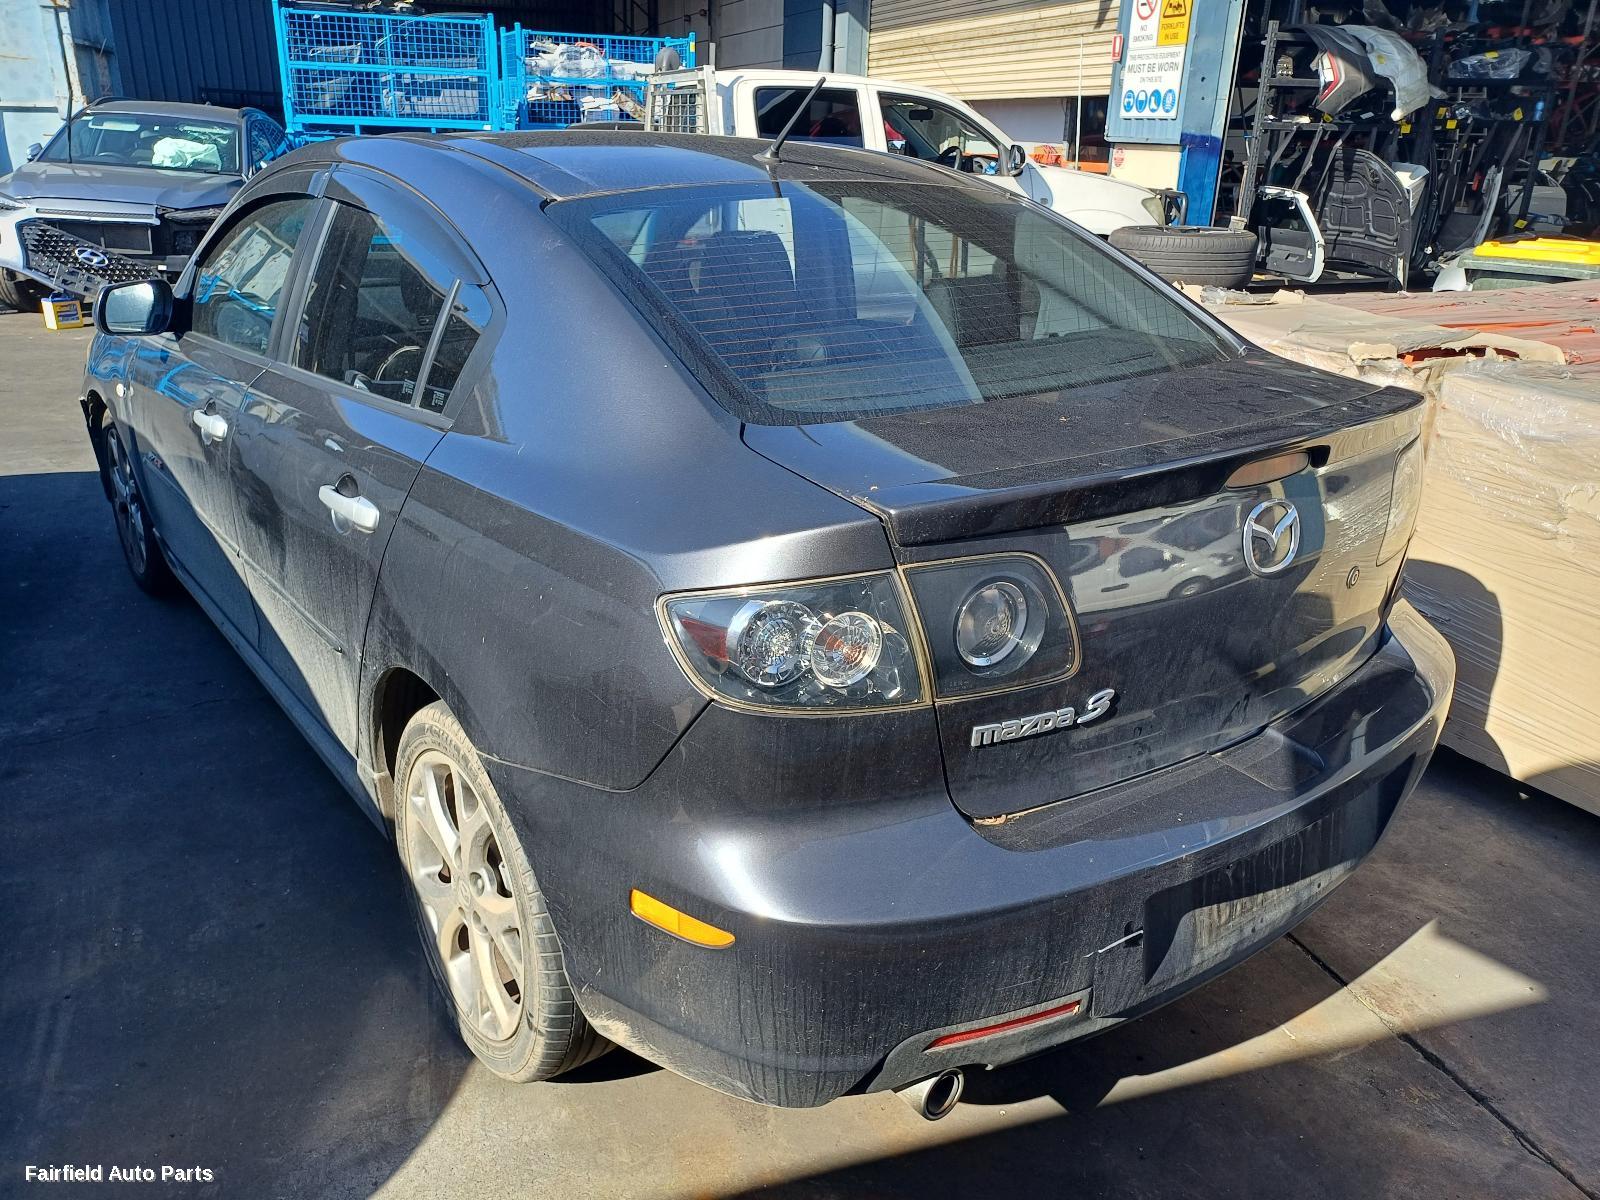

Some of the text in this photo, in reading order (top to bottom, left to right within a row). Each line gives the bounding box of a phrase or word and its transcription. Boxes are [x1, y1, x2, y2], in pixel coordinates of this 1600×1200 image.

[1133, 34, 1153, 42] SMOKING
[1127, 61, 1179, 73] MUST BE WORN
